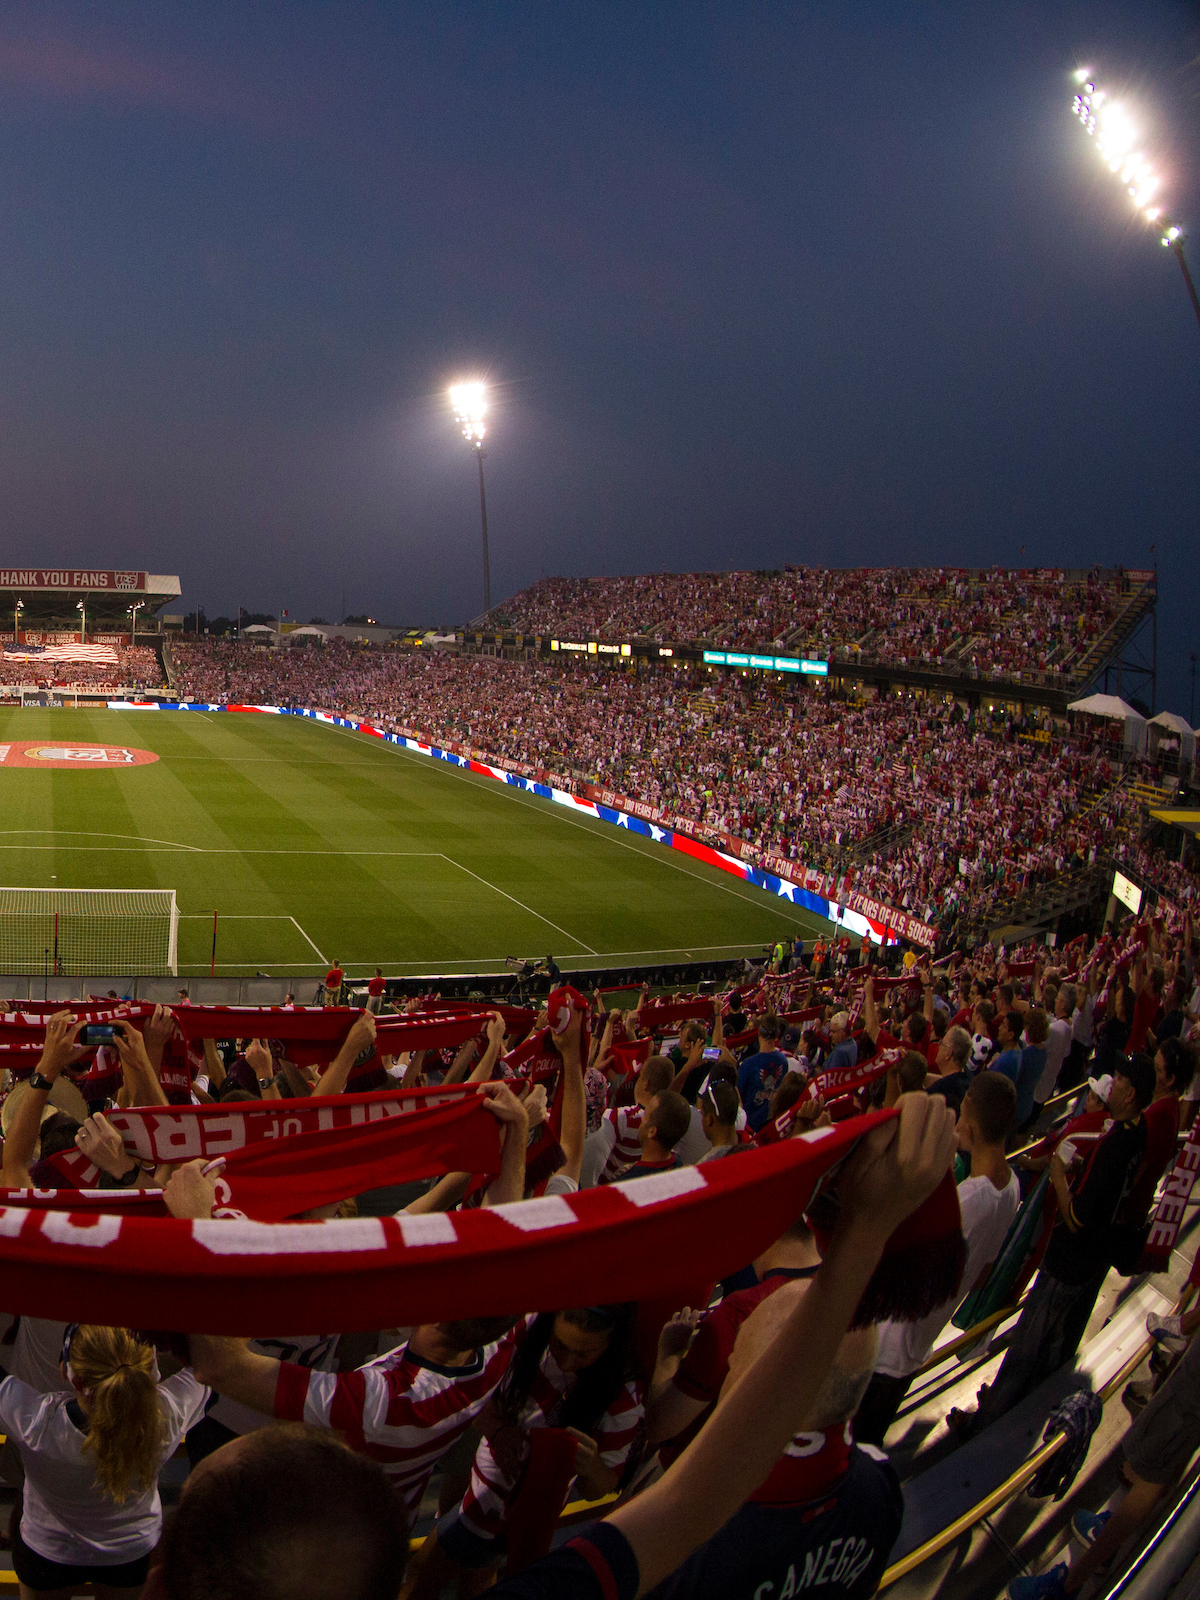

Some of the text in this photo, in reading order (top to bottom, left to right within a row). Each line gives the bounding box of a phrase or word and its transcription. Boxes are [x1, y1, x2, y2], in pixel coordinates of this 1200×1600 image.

[42, 573, 69, 586] YOU
[73, 573, 108, 587] FANS
[93, 635, 123, 644] #USMNT
[624, 798, 635, 812] 100
[634, 801, 653, 819] YEARS
[853, 894, 878, 920] YEARS
[879, 905, 891, 925] OF
[889, 914, 906, 935] U.S.
[1145, 1140, 1200, 1247] FREE
